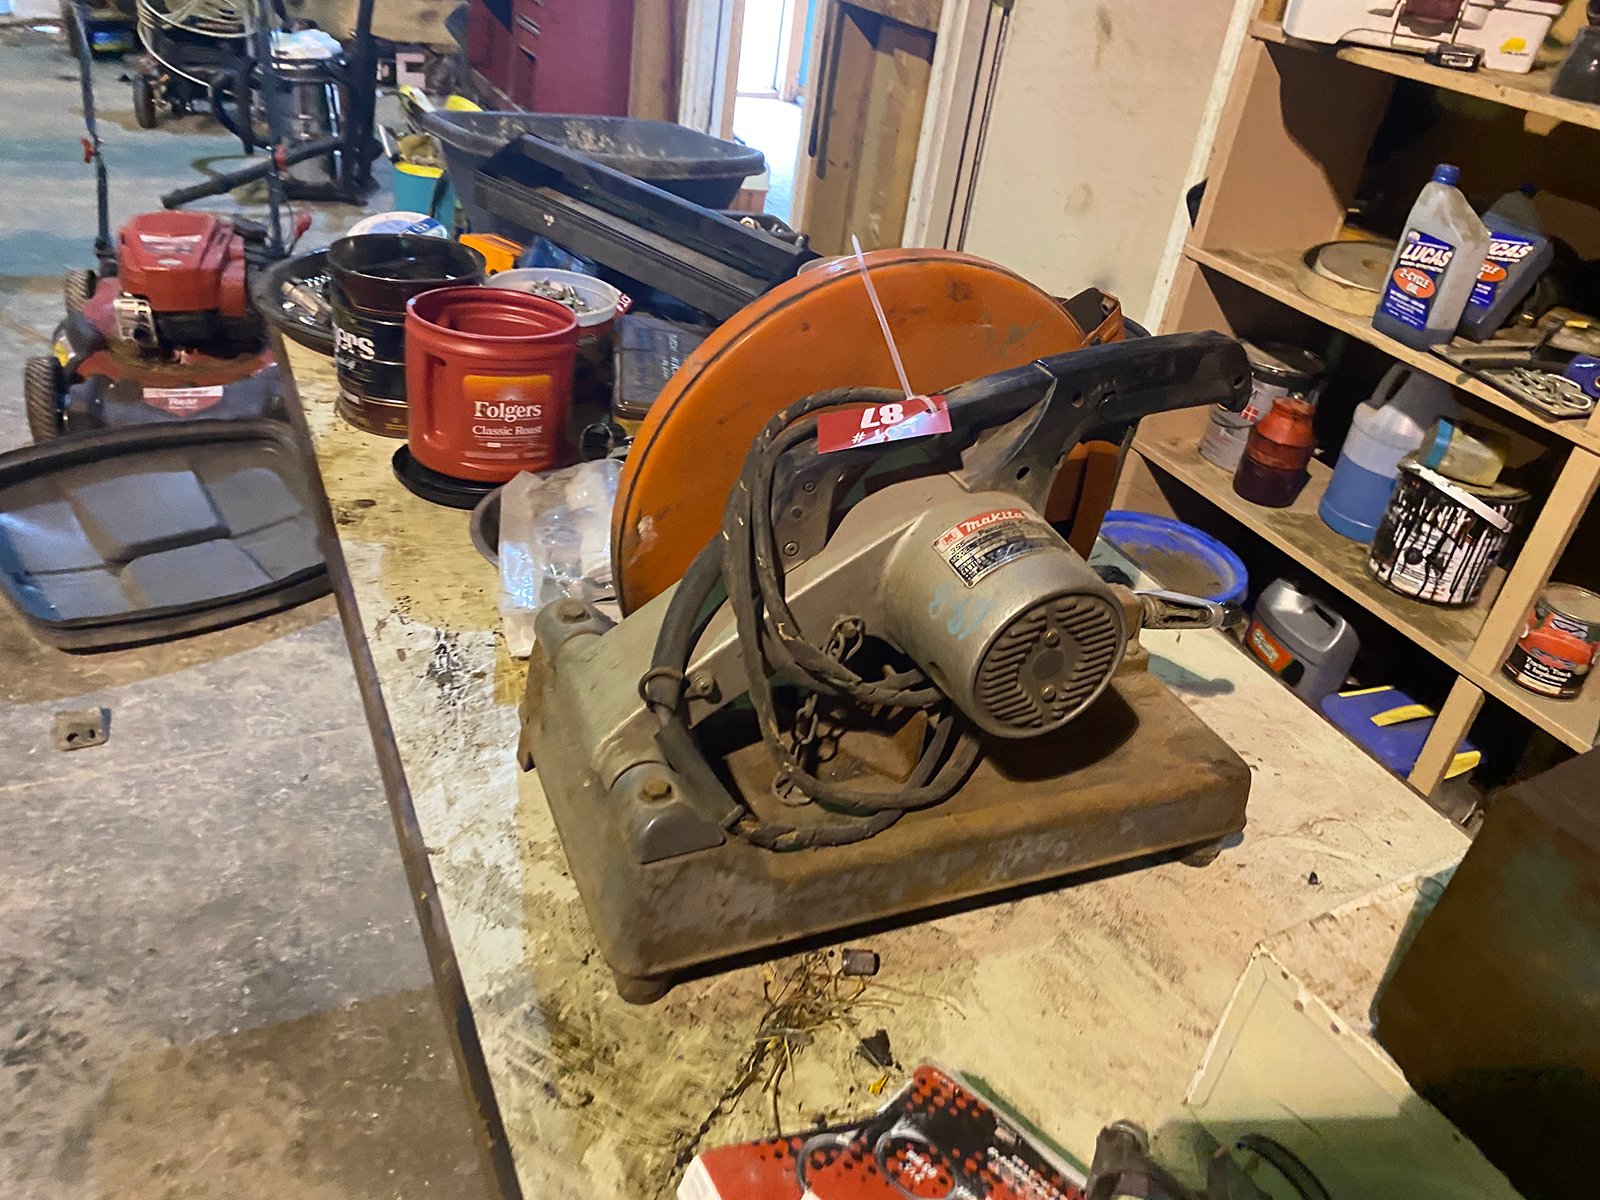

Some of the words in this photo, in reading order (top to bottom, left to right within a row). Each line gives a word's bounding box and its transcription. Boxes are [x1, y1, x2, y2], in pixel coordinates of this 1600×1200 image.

[1400, 244, 1453, 267] LUCAS
[473, 401, 542, 423] Folgers
[860, 403, 904, 430] 87
[472, 425, 513, 435] Classic
[515, 425, 543, 435] Roast
